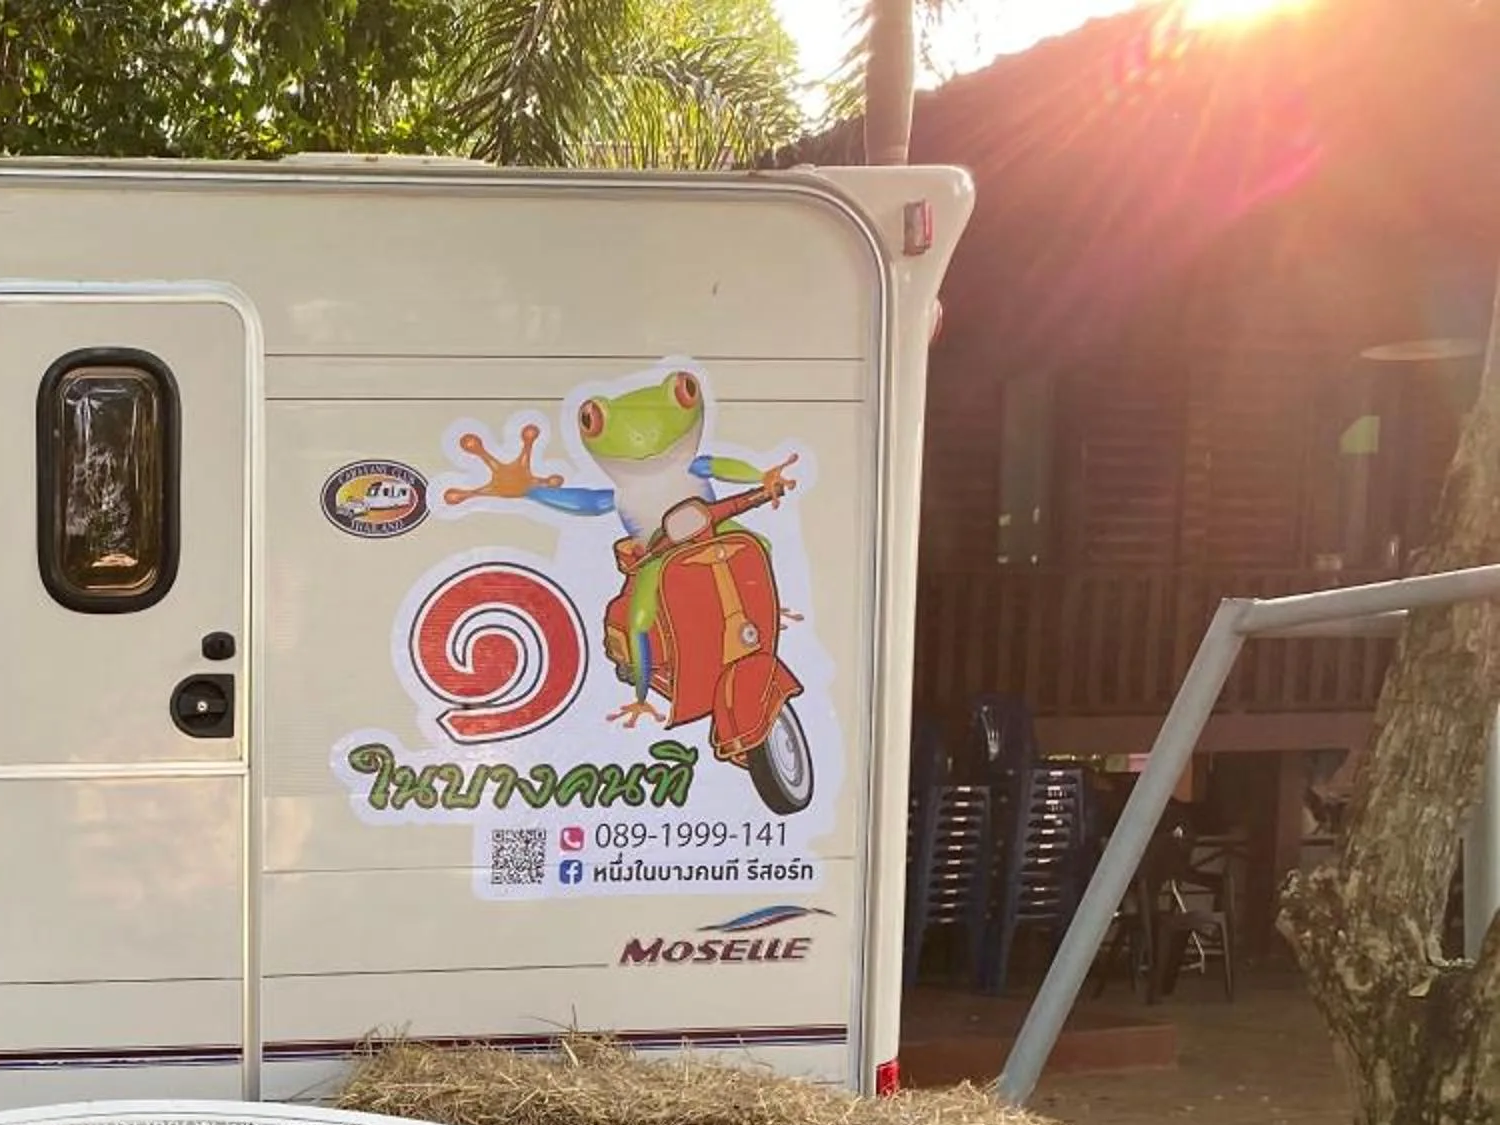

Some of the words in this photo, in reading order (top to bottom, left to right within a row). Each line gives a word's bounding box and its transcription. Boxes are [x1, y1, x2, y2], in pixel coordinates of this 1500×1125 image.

[348, 739, 699, 810] ในบางคนที
[595, 821, 786, 849] 089-1999-141
[593, 851, 739, 882] หนึ่งในบางคนที
[747, 857, 814, 881] รีสอร์ท
[618, 936, 814, 965] MOSELLE
